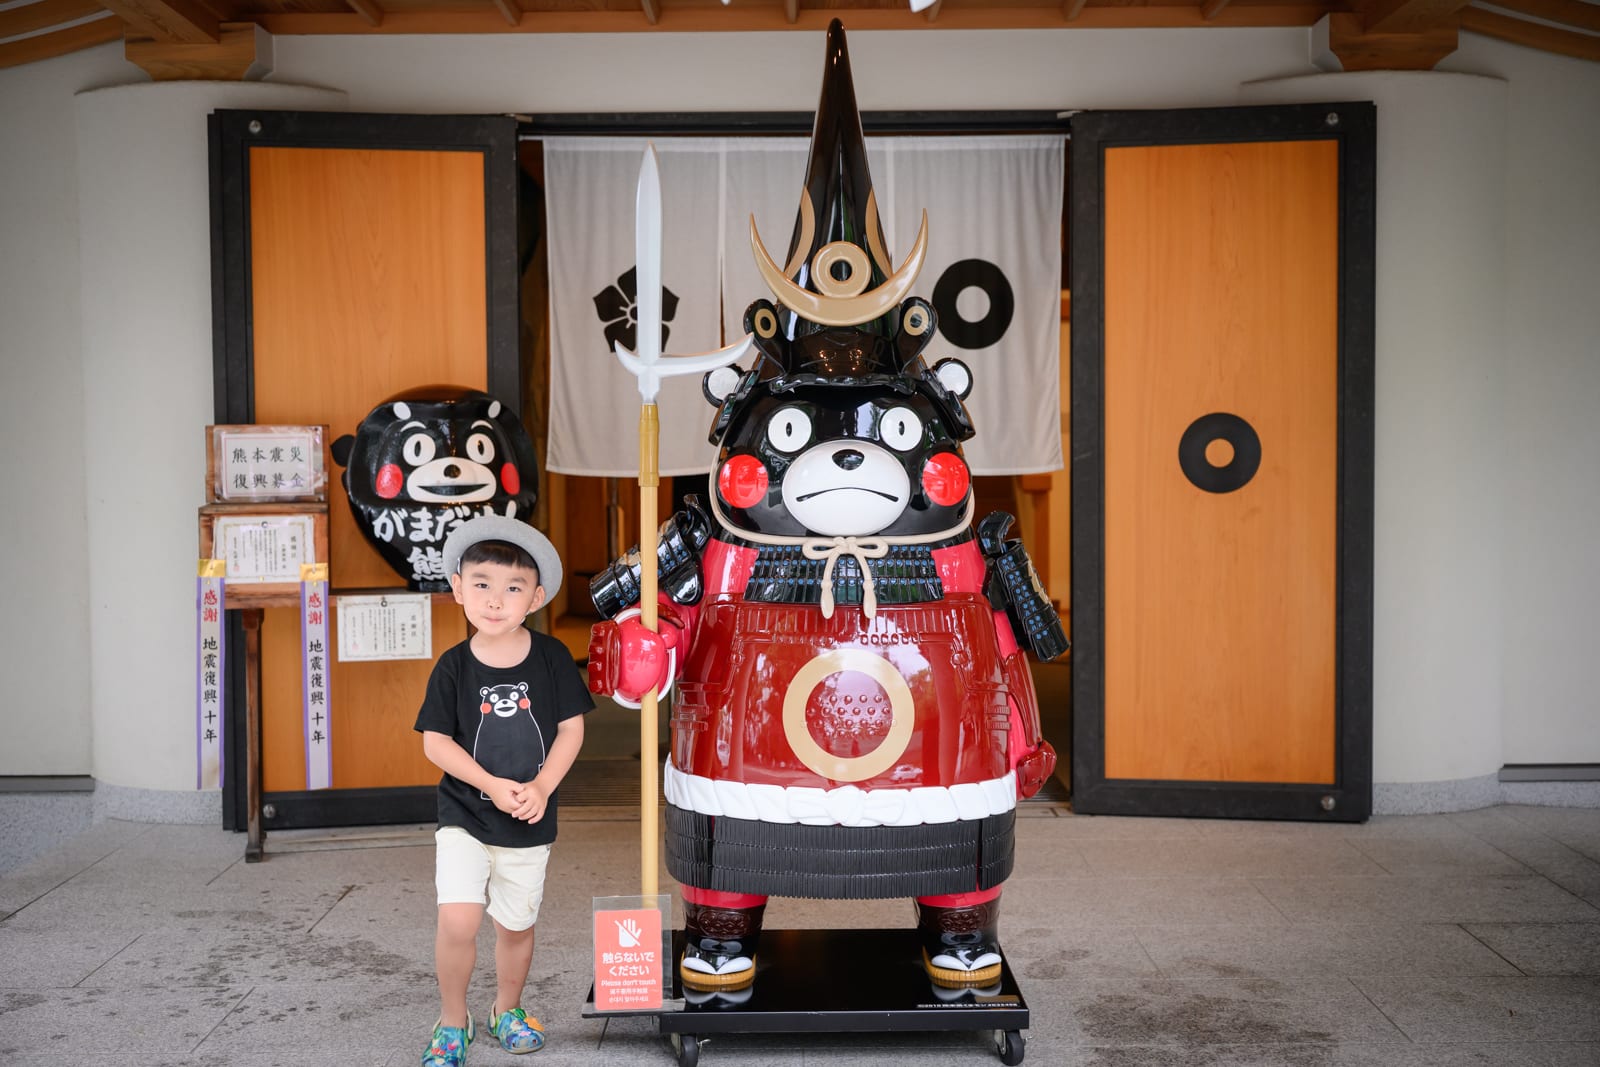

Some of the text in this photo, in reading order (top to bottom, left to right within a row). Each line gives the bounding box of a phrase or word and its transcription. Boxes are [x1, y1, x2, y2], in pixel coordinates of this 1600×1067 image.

[232, 446, 304, 464] 熊本震災
[232, 472, 305, 489] 復興募金
[202, 589, 218, 744] 感謝 地震復興十年
[308, 592, 325, 744] 感謝 地震復興十年
[602, 952, 654, 964] 触らないで
[609, 965, 650, 976] ください
